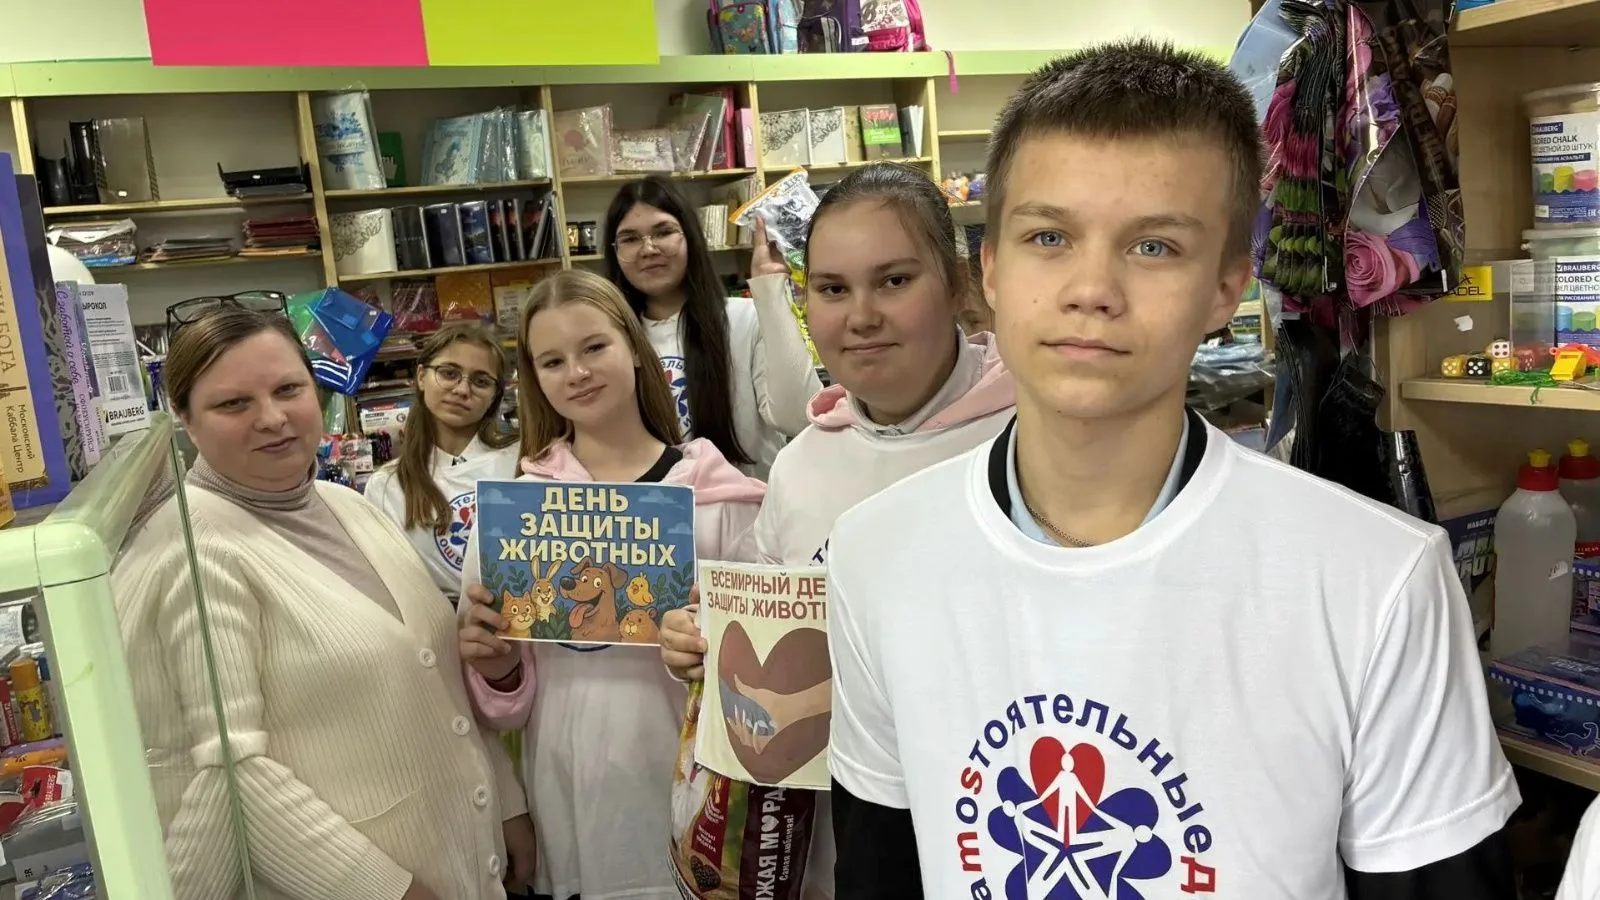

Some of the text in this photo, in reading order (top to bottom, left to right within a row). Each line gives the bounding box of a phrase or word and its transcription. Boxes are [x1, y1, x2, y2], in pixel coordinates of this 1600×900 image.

[1552, 134, 1578, 143] CHALK
[1571, 142, 1594, 151] ШТУК
[1450, 286, 1486, 296] ADEL
[1555, 275, 1592, 283] COLORED
[70, 359, 81, 385] себе
[108, 405, 145, 421] BRAUBERG
[6, 405, 25, 473] Каббала Центр
[18, 403, 36, 460] Московский
[541, 487, 629, 512] ДЕНЬ
[520, 512, 660, 541] ЗАЩИТЫ
[498, 538, 676, 567] ЖИВОТНЫХ
[711, 570, 791, 596] ВСЕМИРНЫЙ
[707, 591, 748, 616] ЗАЩИТЫ
[779, 855, 791, 881] Самая
